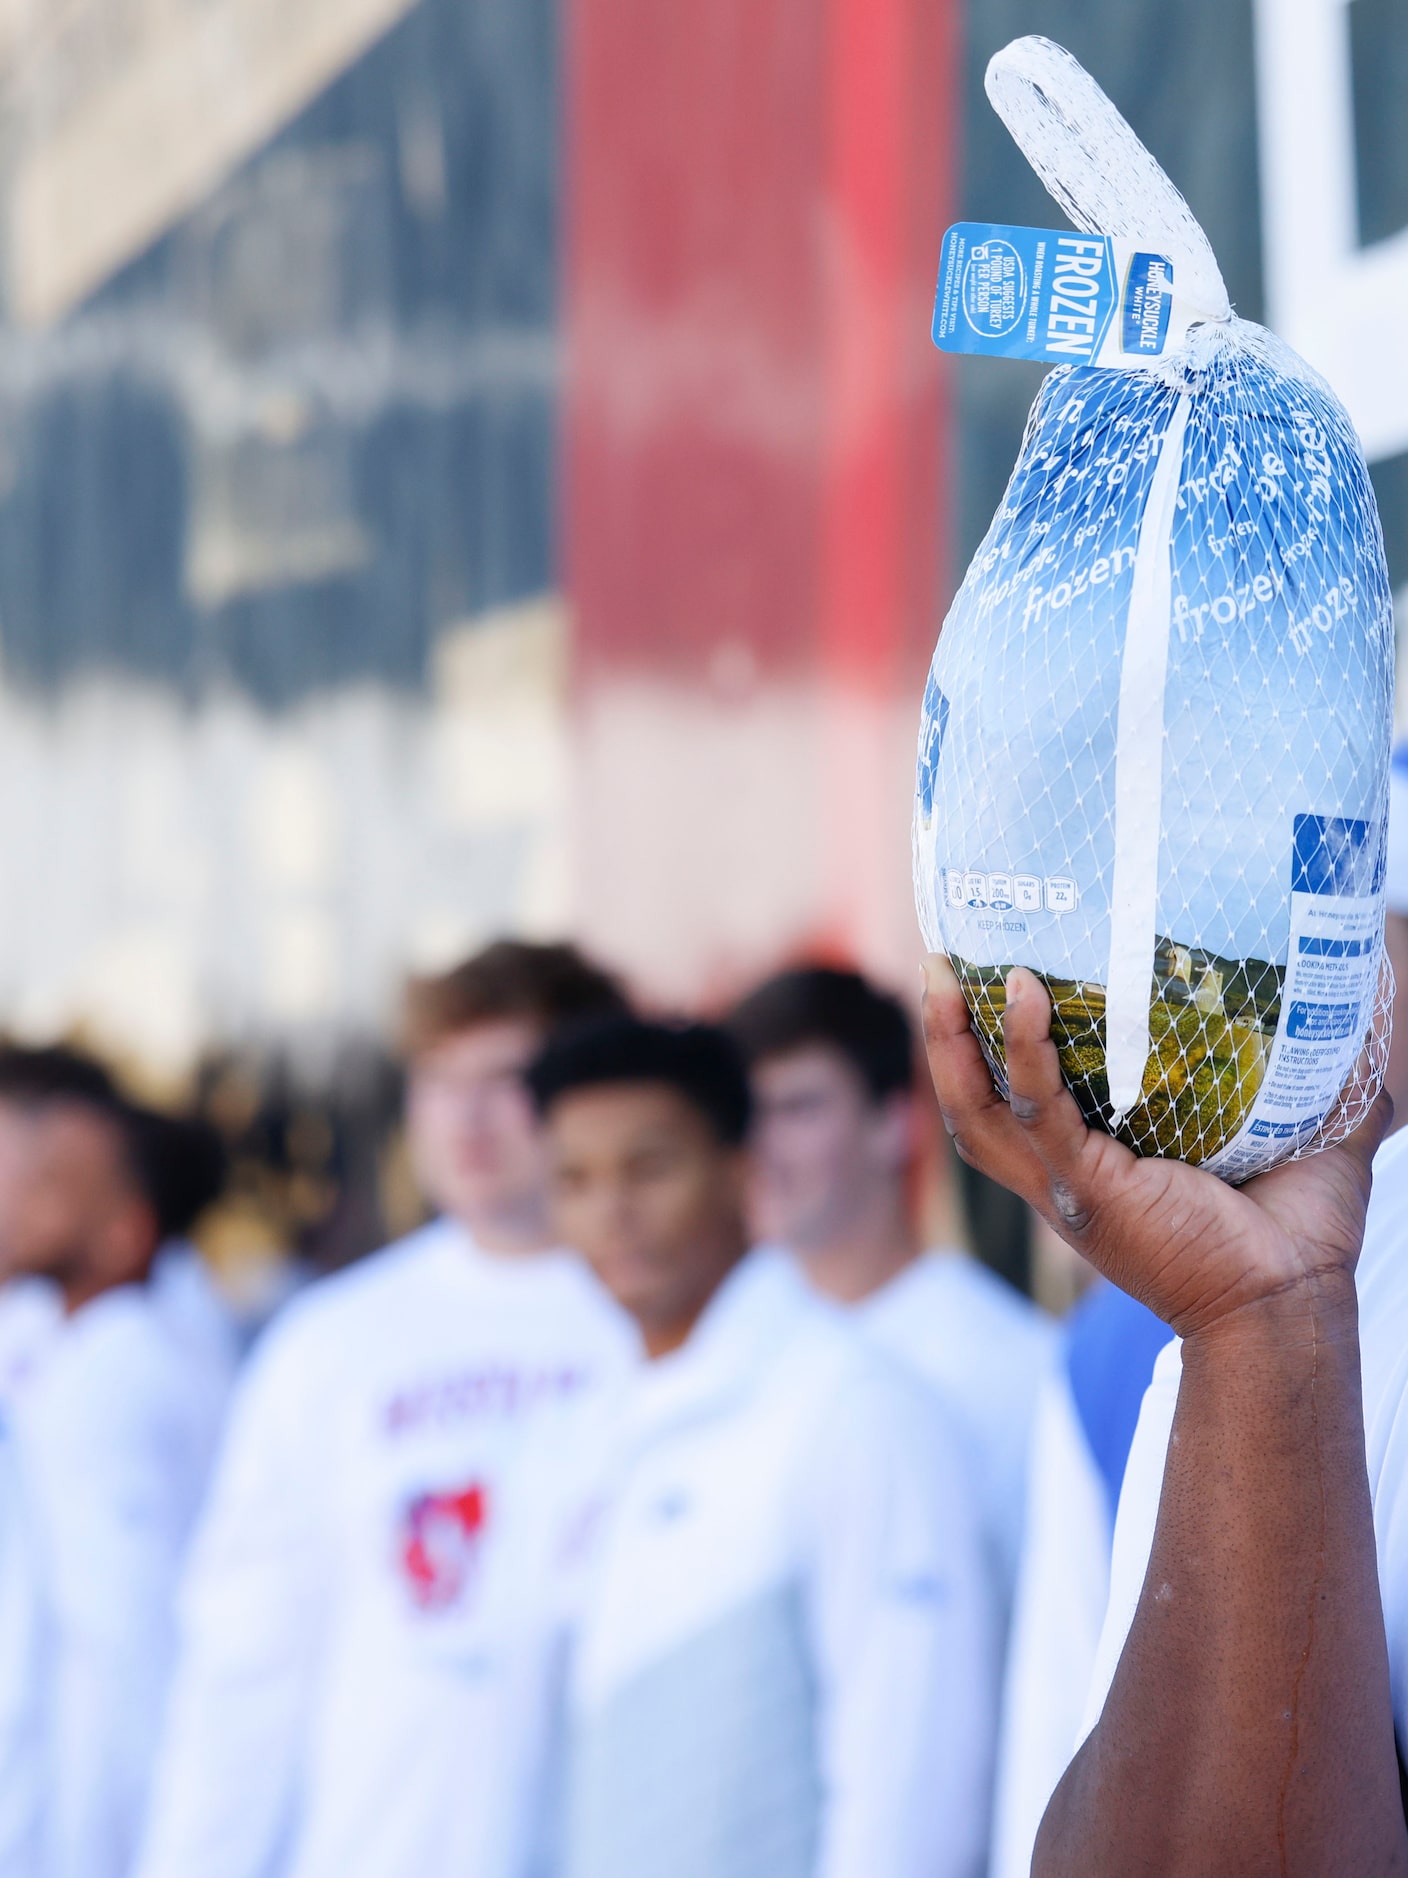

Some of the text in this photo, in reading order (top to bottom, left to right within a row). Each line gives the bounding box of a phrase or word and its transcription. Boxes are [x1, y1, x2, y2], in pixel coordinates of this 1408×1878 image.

[957, 238, 965, 259] MORE
[1036, 242, 1046, 260] WHEN
[954, 260, 962, 289] RECIPES
[990, 255, 1002, 283] POUND
[1032, 260, 1044, 289] ROASTING
[938, 232, 958, 338] HONEYSUCKLEWHITE.COM
[977, 263, 990, 313] PER PERSON
[990, 285, 1002, 296] OF
[1002, 256, 1015, 320] USDA SUGGESTS
[1044, 238, 1104, 355] FROZEN
[950, 296, 959, 311] TIPS
[989, 299, 1002, 329] TURKEY
[1029, 296, 1040, 317] WHOLE
[1139, 261, 1166, 349] HONEYSUCKLE
[1026, 318, 1037, 343] TURKEY:
[1022, 545, 1138, 633] frozen
